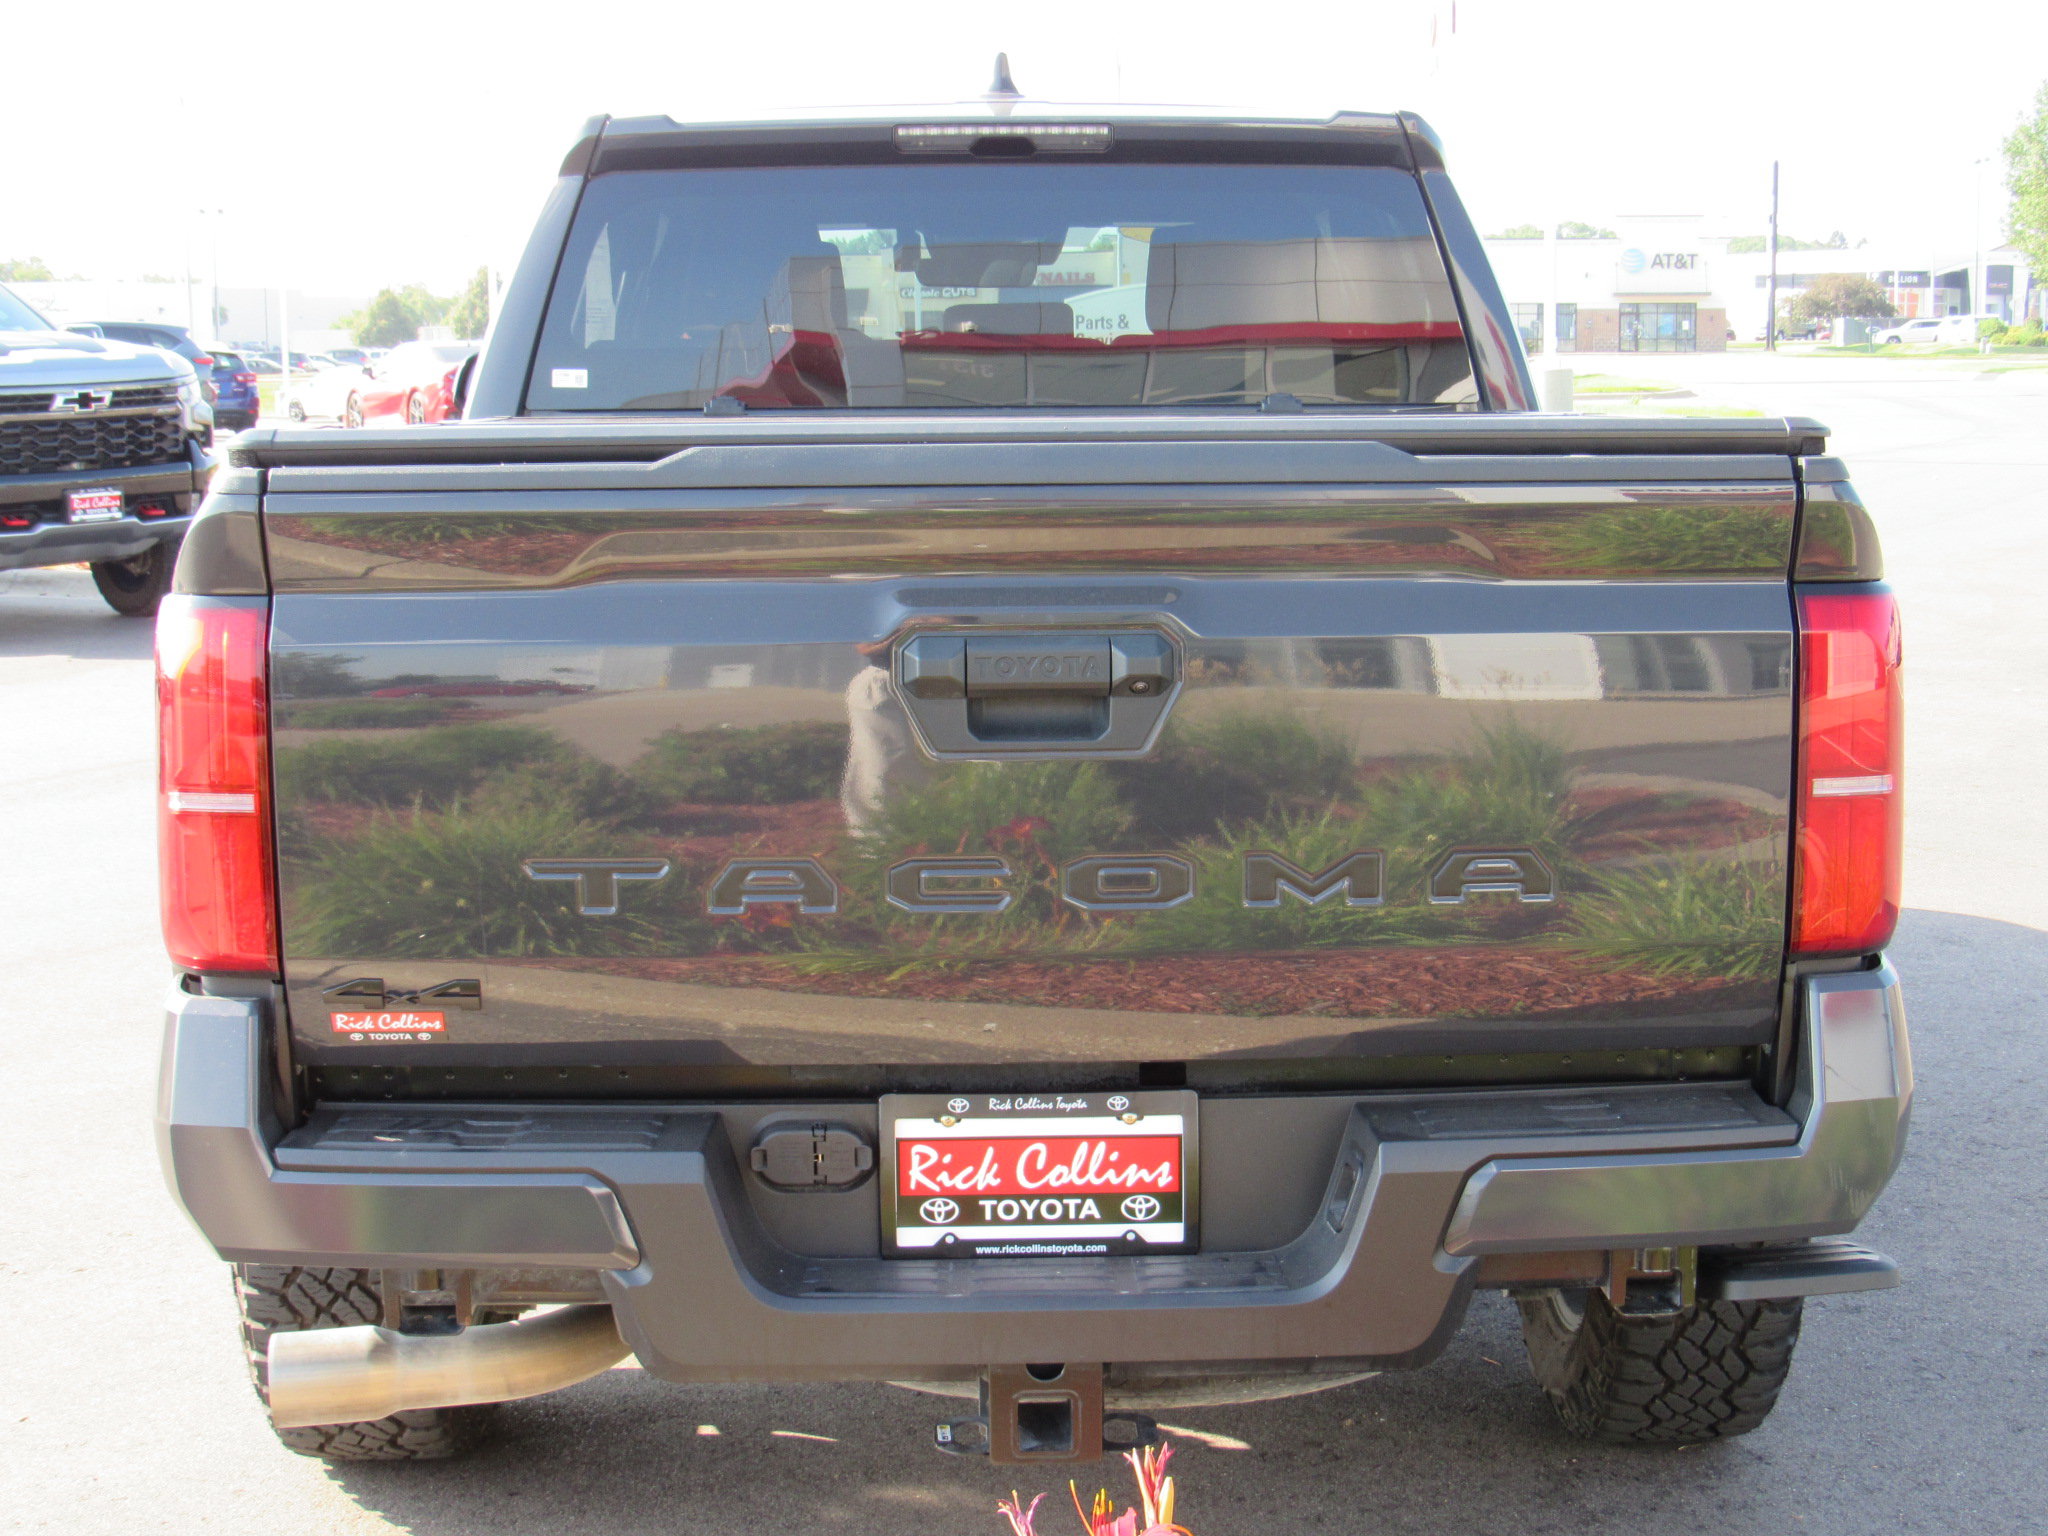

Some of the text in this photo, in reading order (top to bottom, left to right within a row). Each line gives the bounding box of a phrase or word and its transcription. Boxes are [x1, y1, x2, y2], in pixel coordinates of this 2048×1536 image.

[1650, 253, 1699, 269] AT&T
[1039, 272, 1096, 285] NAILS
[1075, 313, 1130, 330] Parts &
[974, 655, 1101, 679] TOYOTA
[522, 847, 1558, 917] TACOMA
[335, 1013, 443, 1030] Rick Collins
[368, 1033, 413, 1041] TOYOTA
[988, 1096, 1088, 1112] Rick Collins Toyota
[909, 1141, 1173, 1192] Rick Collins
[978, 1198, 1102, 1221] TOYOTA
[975, 1243, 1107, 1256] www.rickcollinstoyota.com
